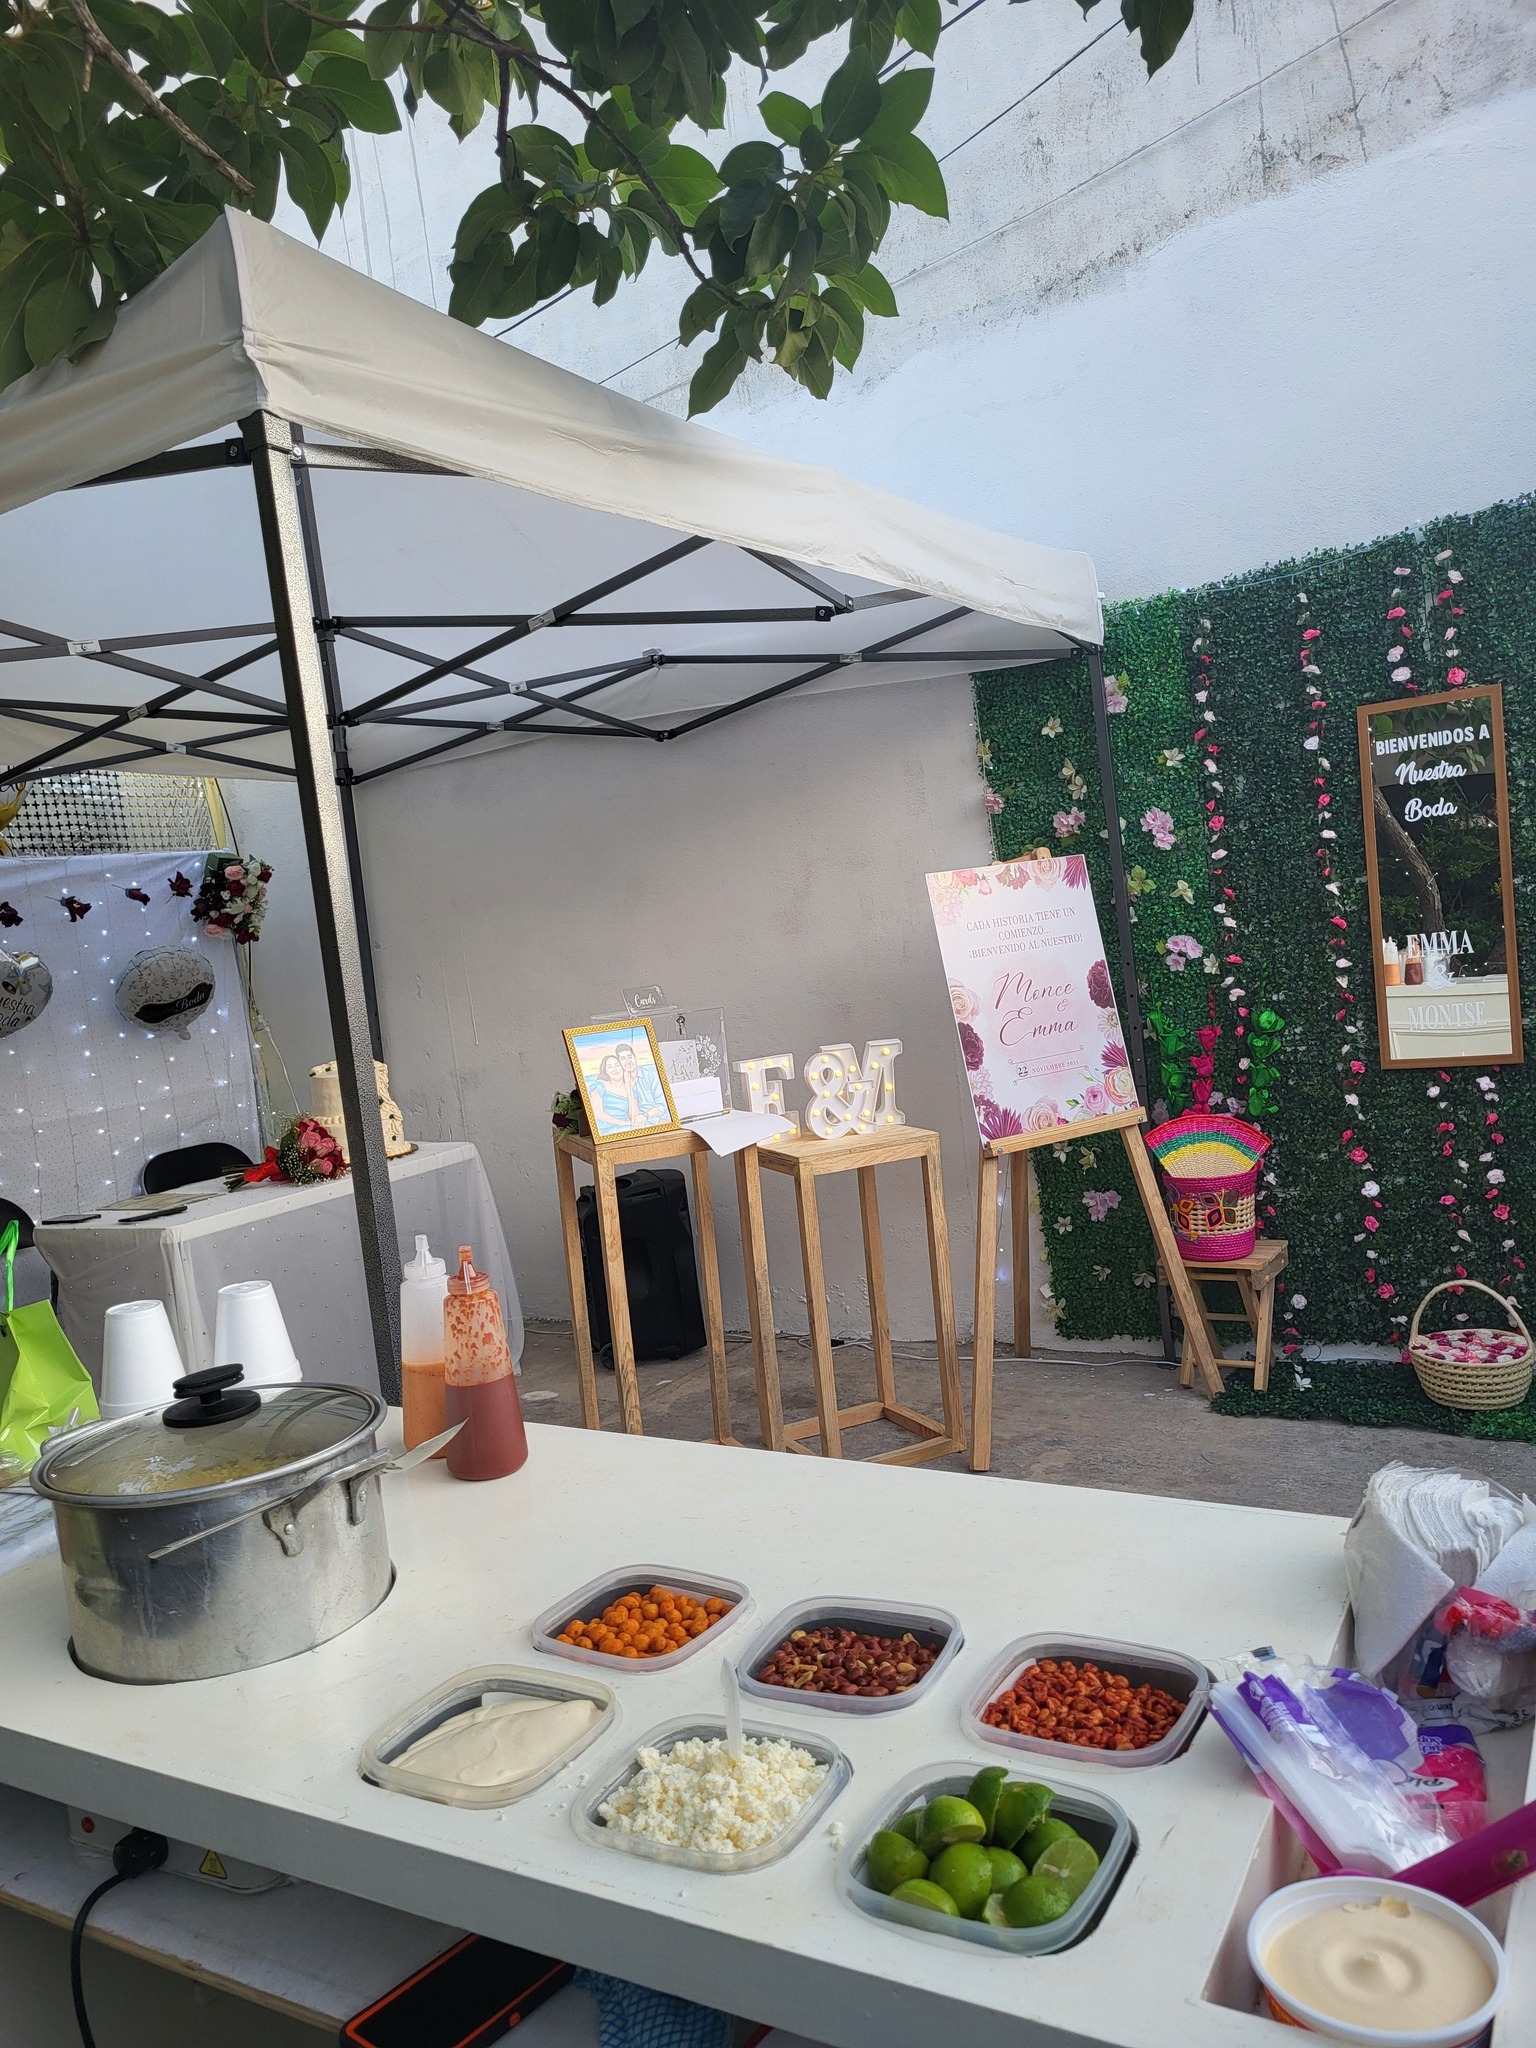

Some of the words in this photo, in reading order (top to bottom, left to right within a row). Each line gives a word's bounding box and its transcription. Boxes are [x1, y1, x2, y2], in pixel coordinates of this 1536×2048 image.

[1375, 726, 1475, 756] BIENVENIDOS
[1479, 723, 1490, 740] A
[1395, 760, 1467, 785] Nuestra
[1404, 797, 1458, 822] Boda
[966, 921, 991, 932] CADA
[992, 913, 1034, 928] HISTORIA
[1035, 908, 1061, 921] TIENE
[1062, 906, 1076, 918] UN
[968, 942, 1026, 959] ¡BIENVENIDO
[1028, 940, 1040, 950] AL
[1040, 933, 1083, 948] NUESTRO!
[1406, 929, 1474, 959] EMMA
[1427, 964, 1457, 990] &
[175, 991, 205, 1012] Boda
[634, 993, 656, 1008] Cards
[994, 971, 1075, 1010] Monce
[1056, 998, 1069, 1012] &
[1407, 1001, 1488, 1031] MONTSE
[1000, 1006, 1079, 1046] Emma
[1017, 1066, 1028, 1075] 22
[1032, 1062, 1065, 1073] NOVIEMBRE
